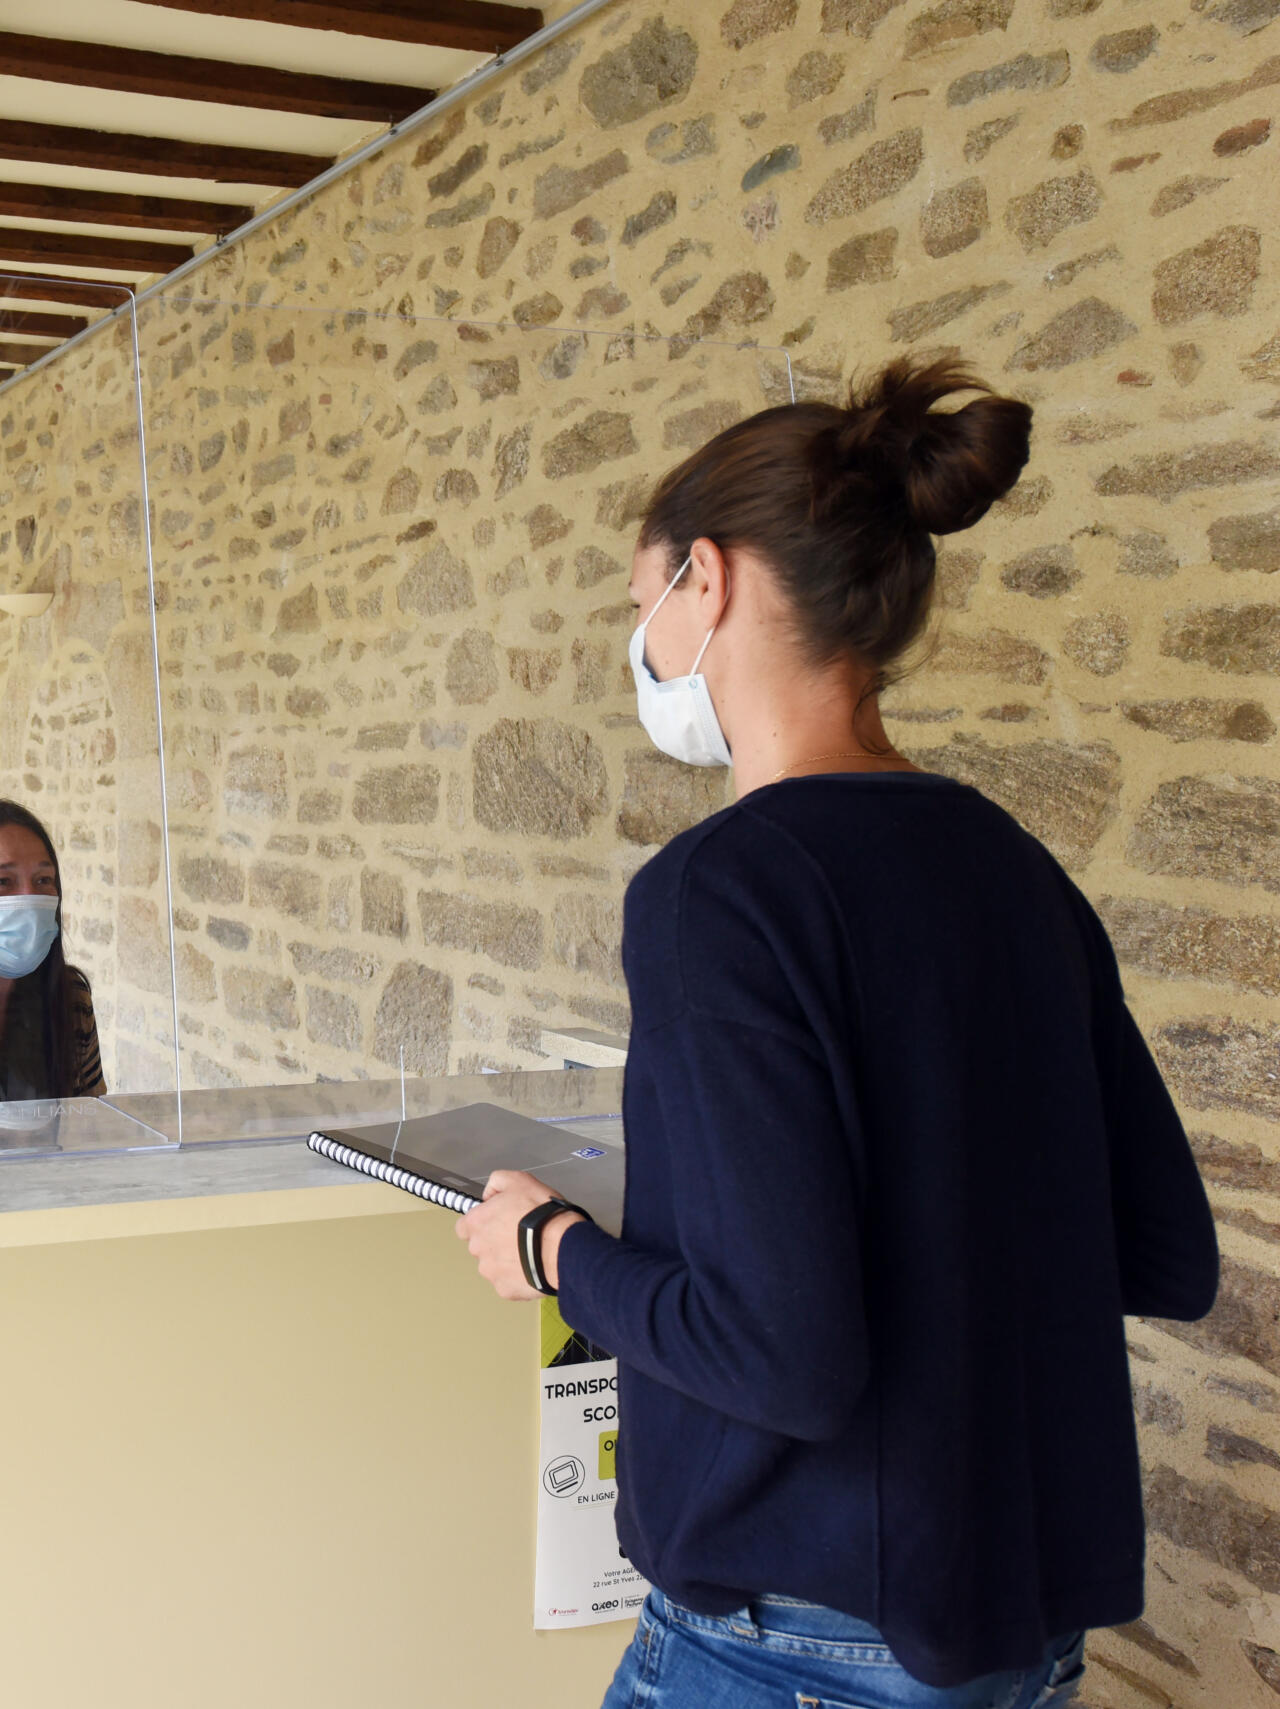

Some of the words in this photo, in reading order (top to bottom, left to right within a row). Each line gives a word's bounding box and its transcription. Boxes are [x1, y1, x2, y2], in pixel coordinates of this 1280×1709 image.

[577, 1495, 589, 1503] EN
[591, 1491, 616, 1502] LIGNE
[604, 1570, 621, 1578] Votre
[591, 1599, 619, 1611] axeo
